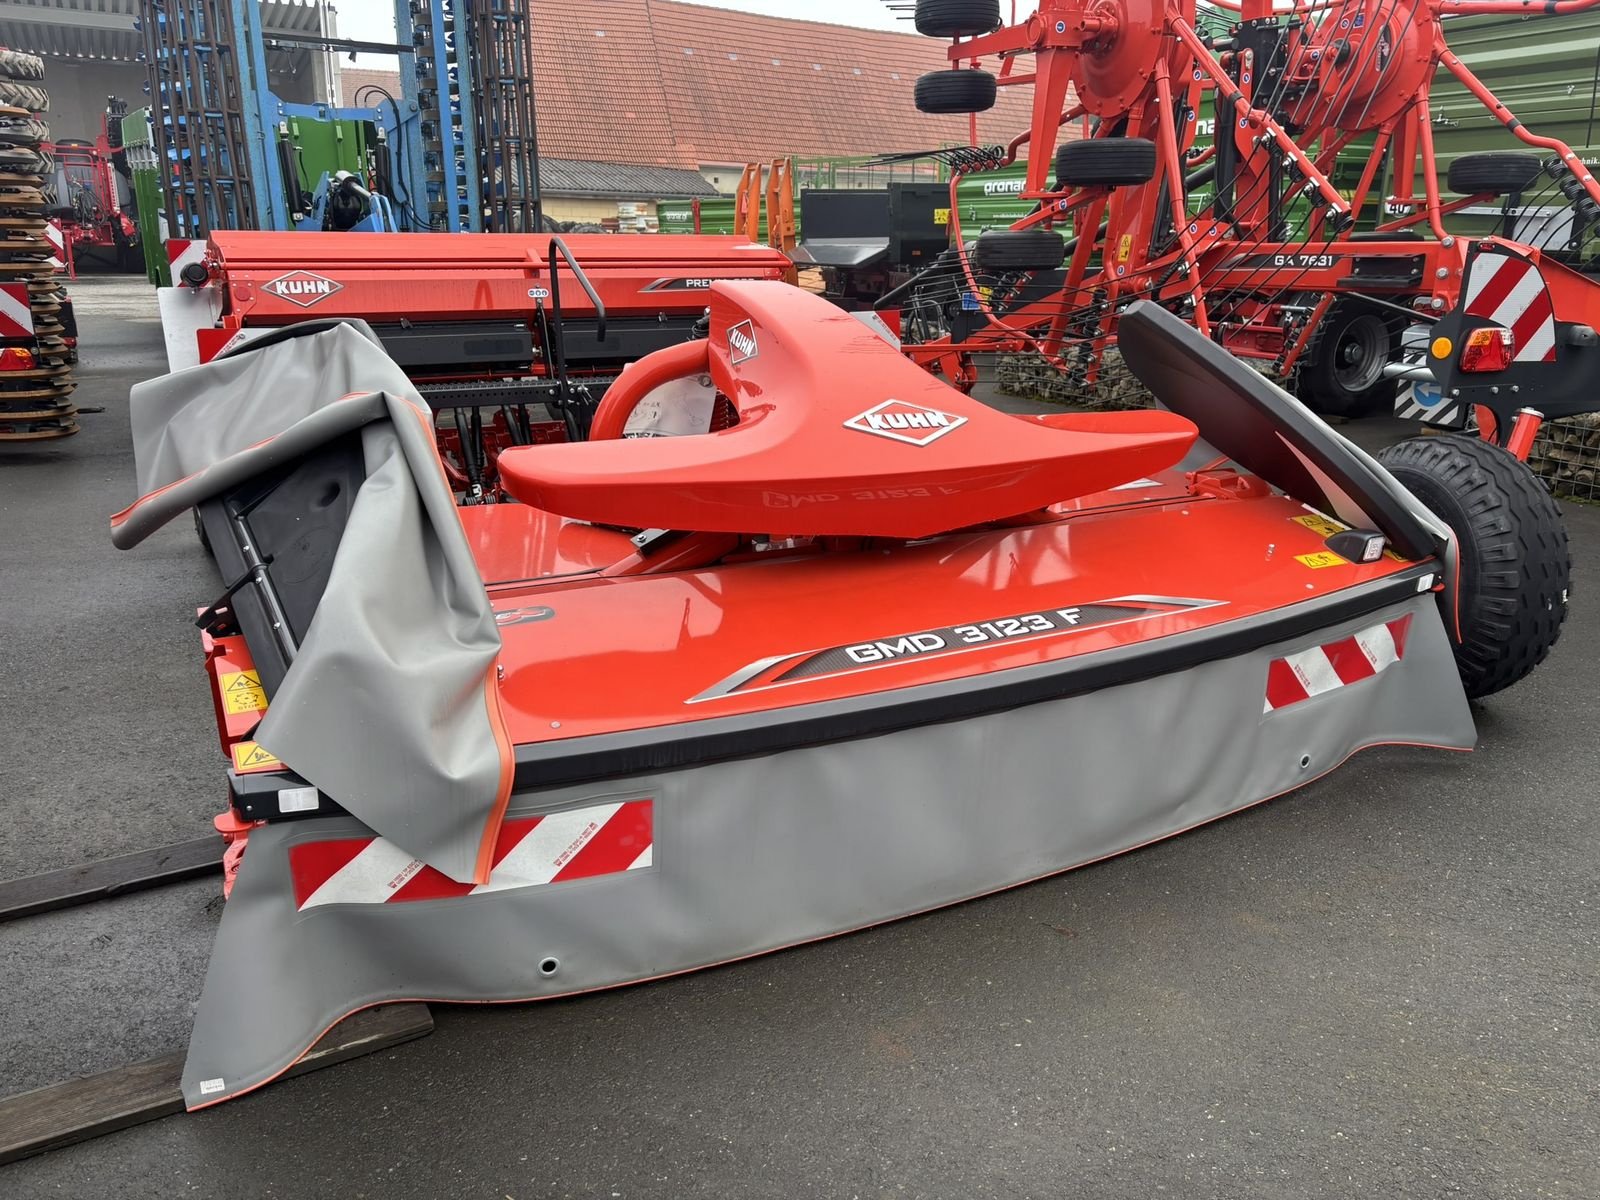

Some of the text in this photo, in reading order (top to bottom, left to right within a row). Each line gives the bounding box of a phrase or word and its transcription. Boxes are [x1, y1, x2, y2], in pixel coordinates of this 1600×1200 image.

[1275, 256, 1333, 266] GA 7631
[275, 280, 330, 294] KUHN
[730, 328, 755, 357] KUHN
[864, 412, 950, 430] KUHN
[845, 607, 1082, 664] GMD 3123 F
